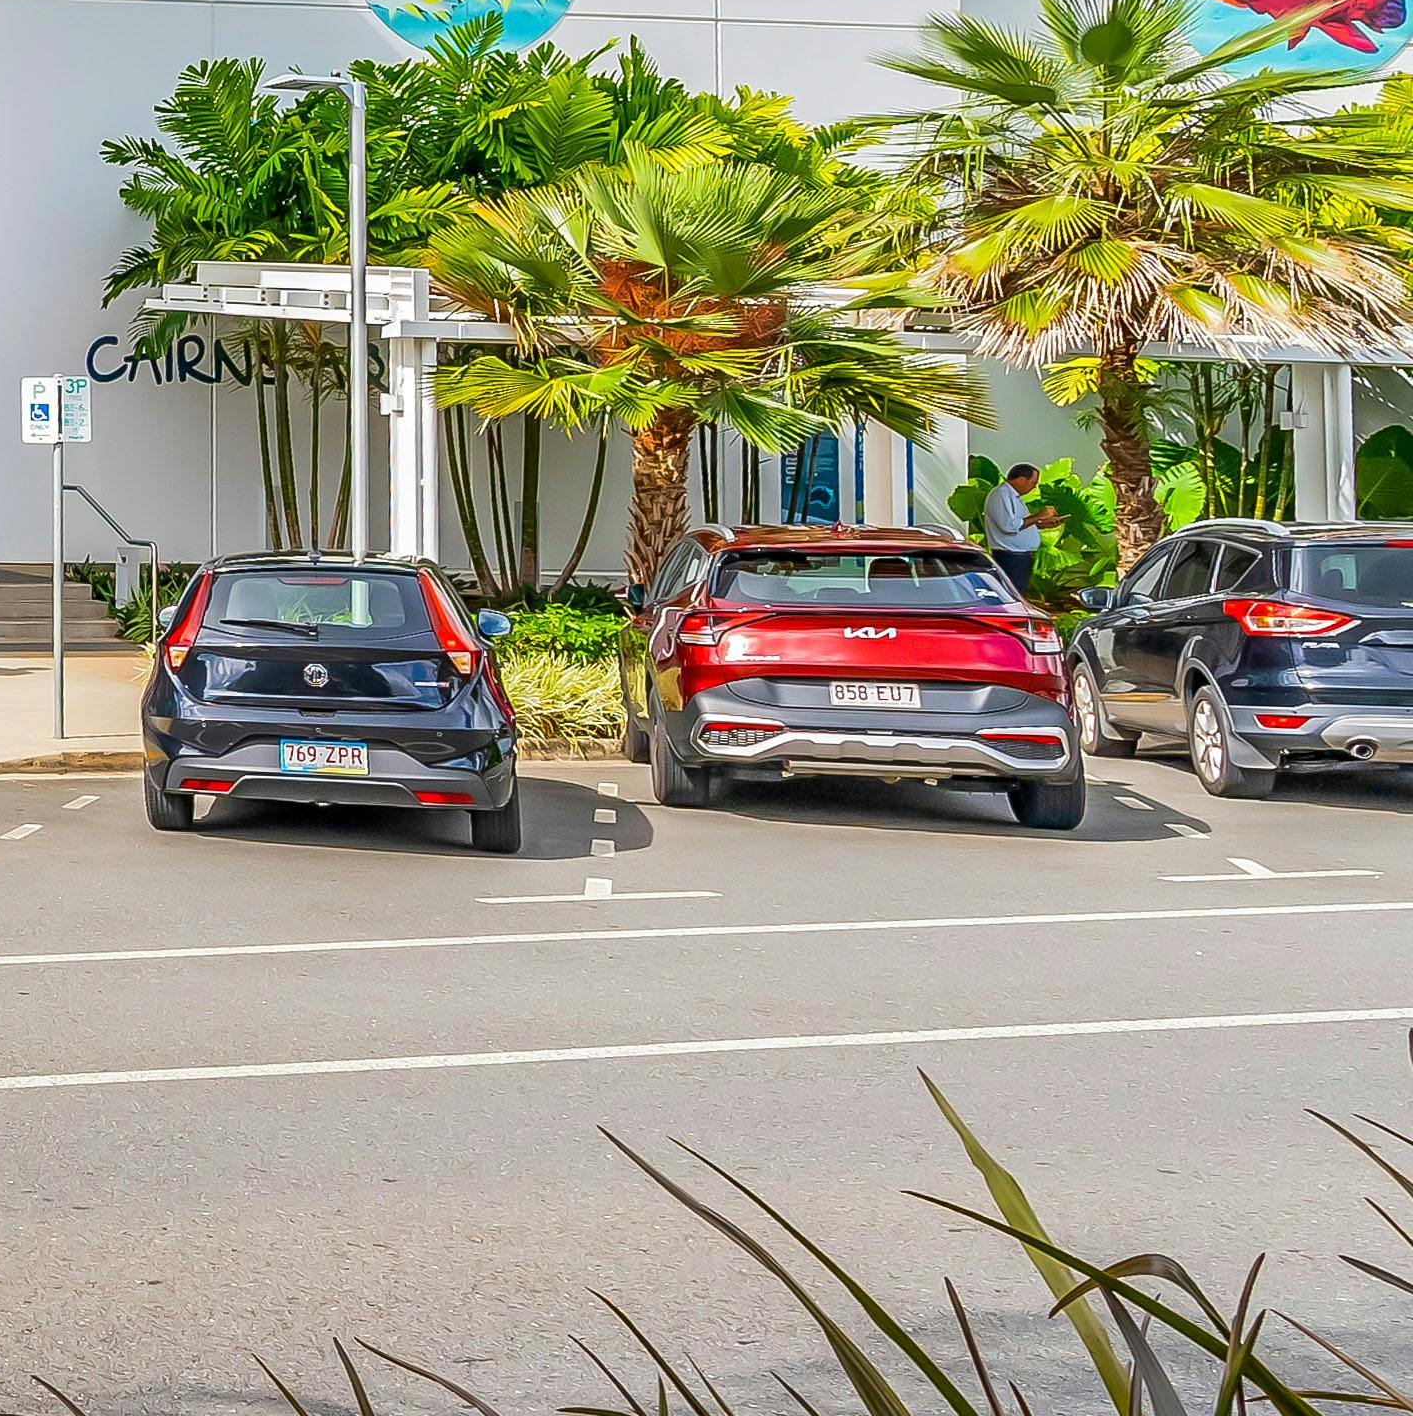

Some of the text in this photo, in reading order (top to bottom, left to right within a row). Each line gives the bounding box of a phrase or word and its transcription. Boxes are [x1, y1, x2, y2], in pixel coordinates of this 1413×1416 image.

[86, 334, 278, 385] CAIRN
[33, 384, 46, 399] P
[65, 378, 87, 393] 3P
